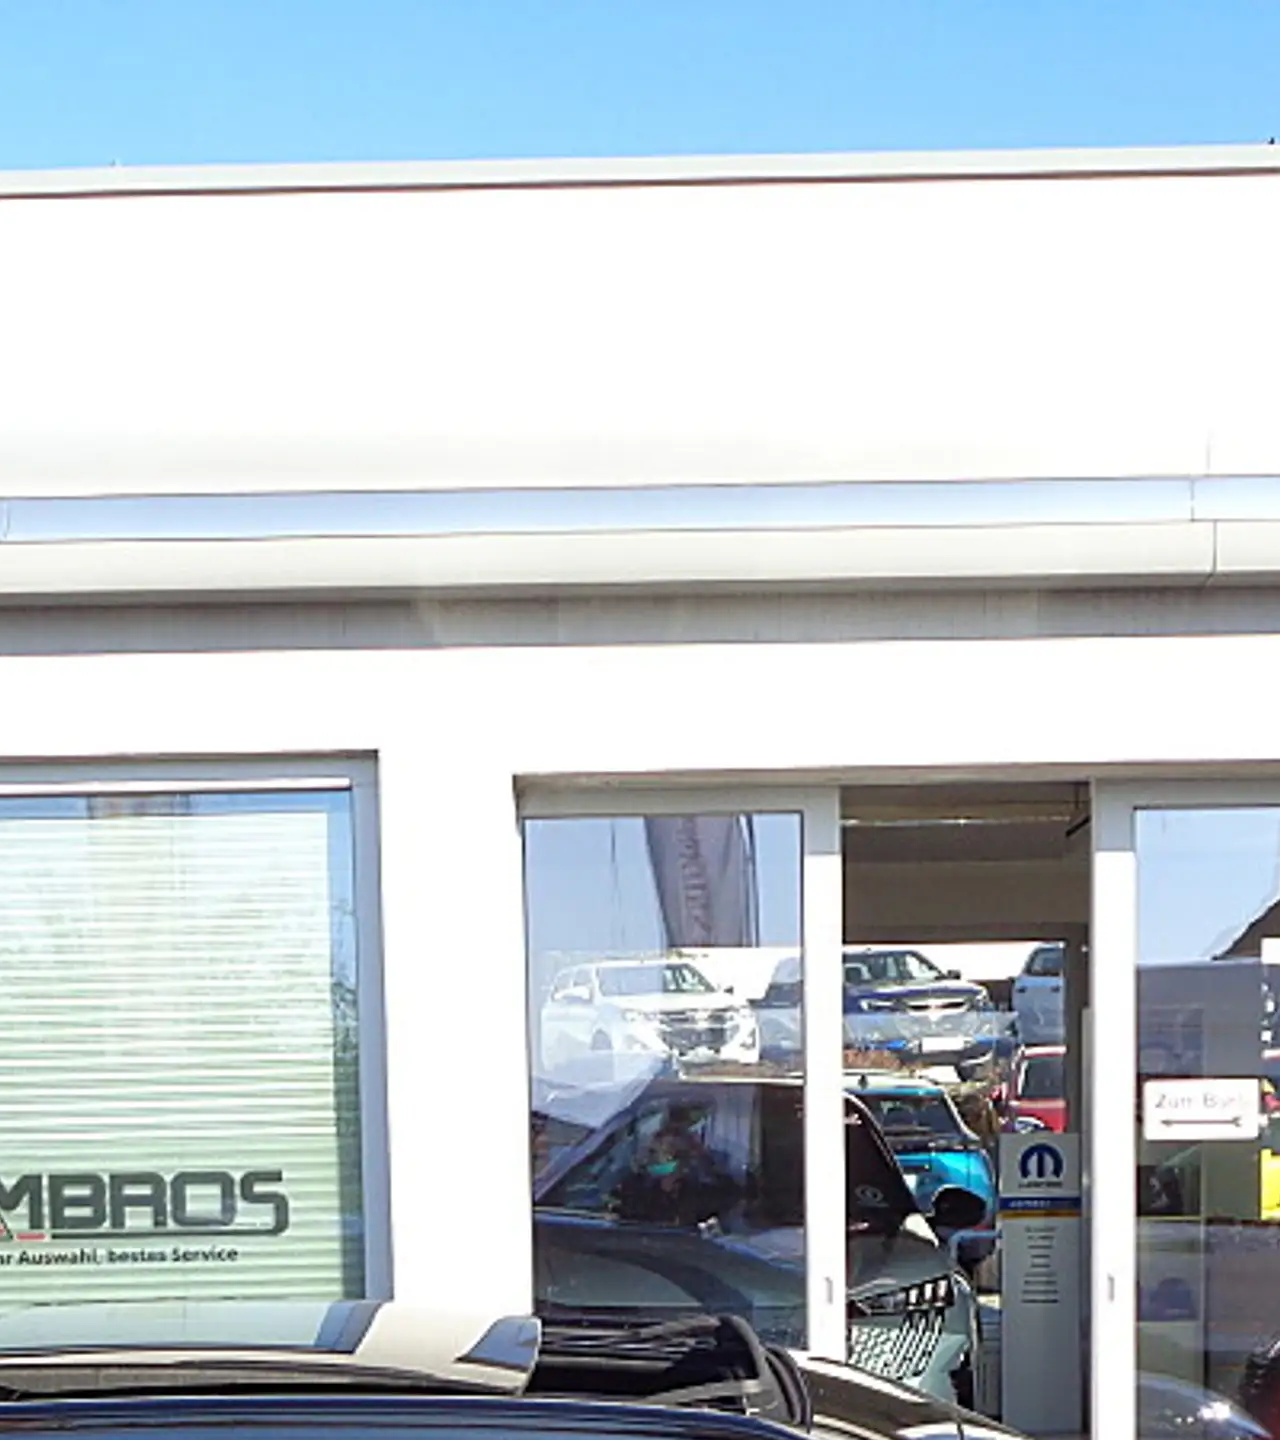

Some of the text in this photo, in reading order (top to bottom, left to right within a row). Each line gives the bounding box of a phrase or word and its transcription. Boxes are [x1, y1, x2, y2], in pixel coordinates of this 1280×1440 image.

[19, 1248, 101, 1266] Auswahl,
[107, 1247, 167, 1263] bestes
[171, 1246, 239, 1262] Service
